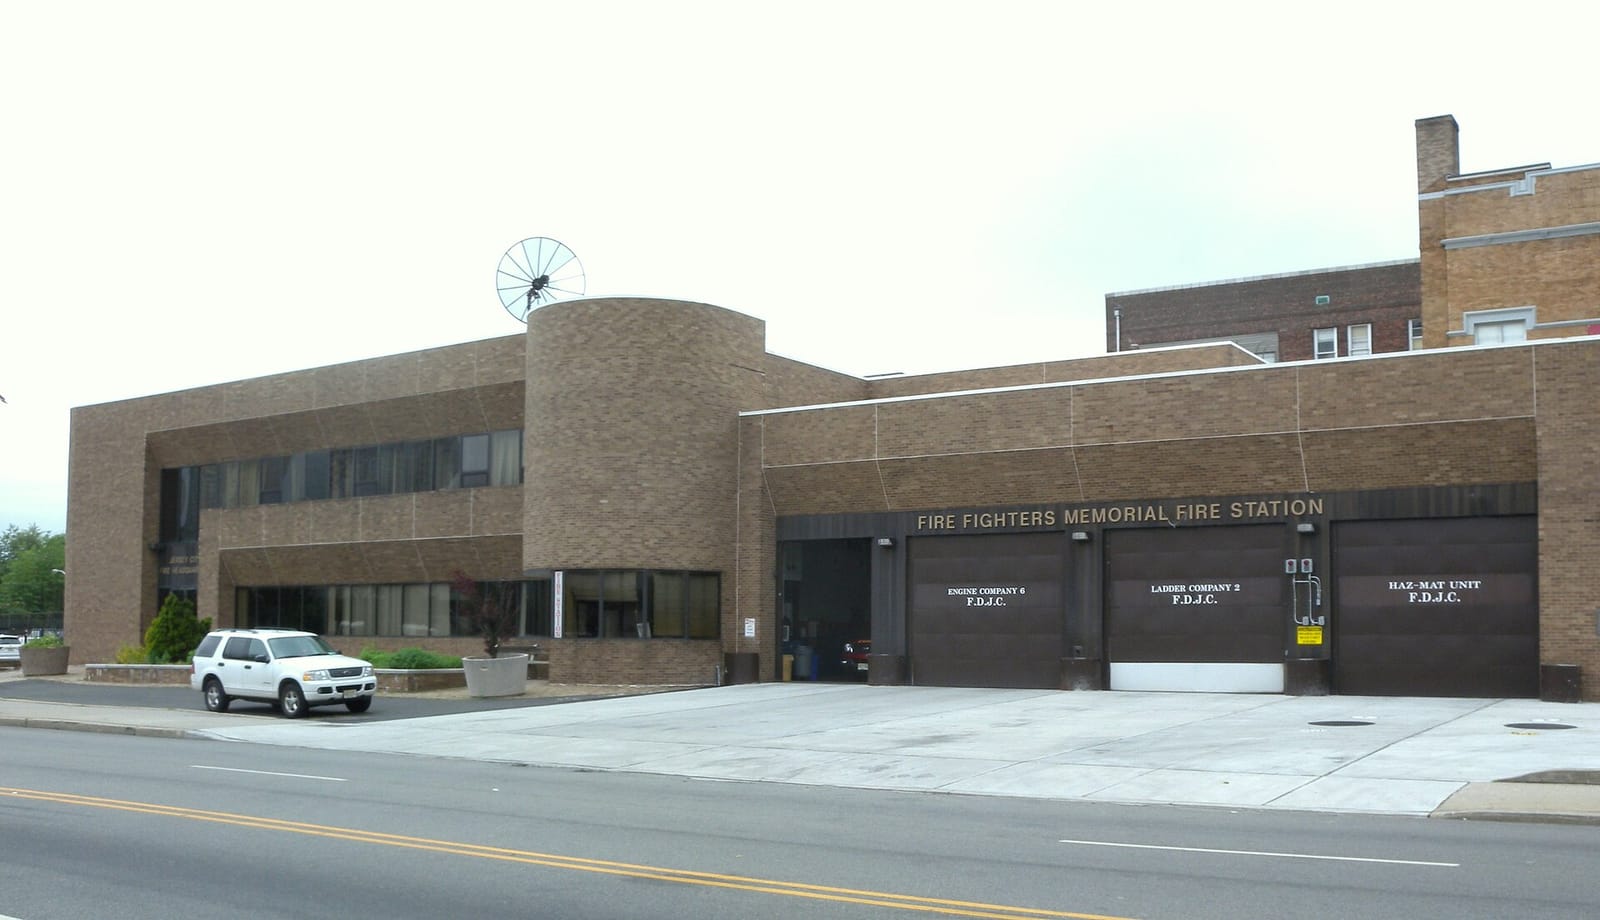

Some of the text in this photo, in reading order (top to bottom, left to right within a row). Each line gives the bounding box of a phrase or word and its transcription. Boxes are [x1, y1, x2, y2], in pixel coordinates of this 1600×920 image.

[917, 498, 1324, 530] FIRE FIGHTERS MEMORIAL FIRE STATION
[1151, 583, 1241, 593] LADDER COMPANY 2
[1388, 580, 1482, 590] HAZ-MAT UNIT
[979, 587, 1018, 595] COMPANY
[1020, 587, 1026, 595] 6
[966, 597, 1007, 607] F.D.J.C.
[1172, 594, 1218, 605] F.D.J.C.
[1408, 591, 1461, 603] F.D.J.C.
